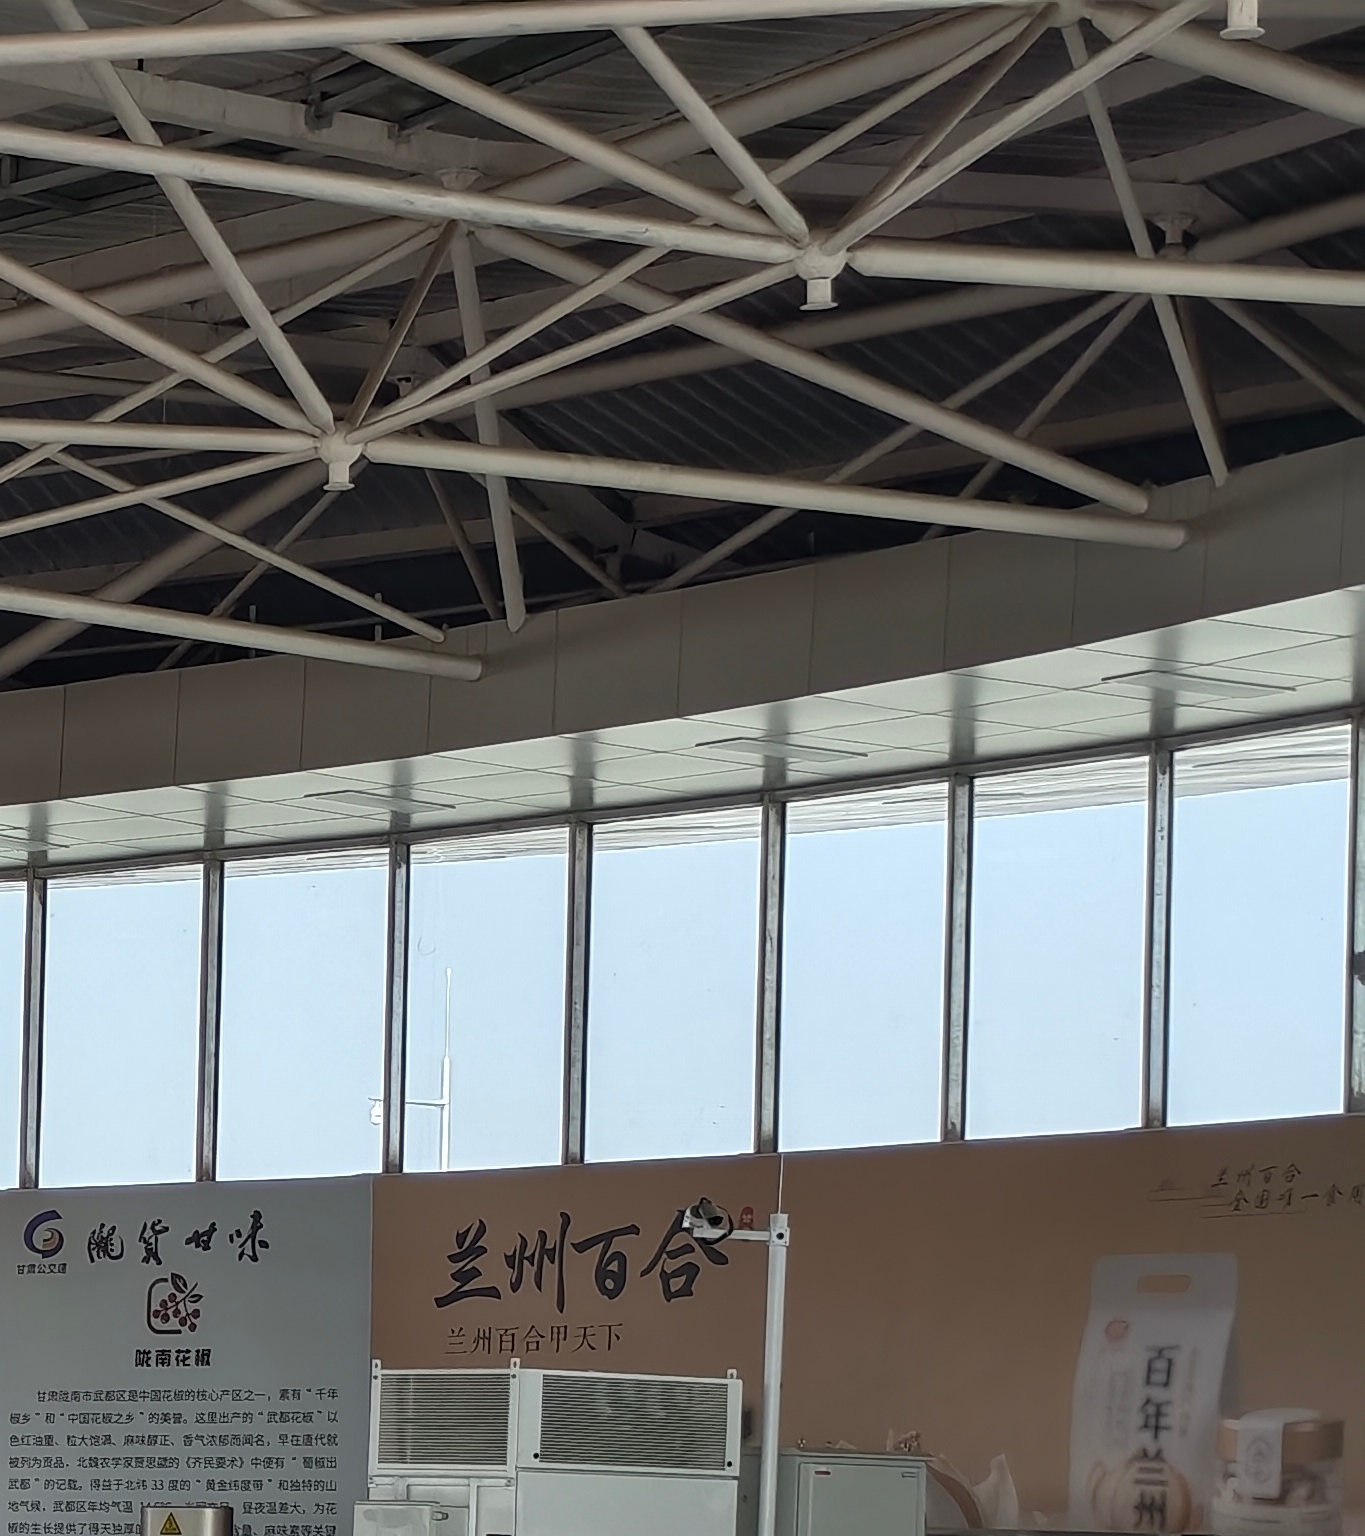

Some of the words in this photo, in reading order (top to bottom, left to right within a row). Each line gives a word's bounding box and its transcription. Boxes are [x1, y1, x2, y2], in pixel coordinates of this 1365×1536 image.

[434, 1210, 730, 1314] 兰州百合
[445, 1323, 624, 1355] 兰州百合甲天下
[135, 1349, 212, 1368] 陇南花椒
[1133, 1345, 1181, 1529] 百年兰州
[150, 1479, 165, 1491] 33
